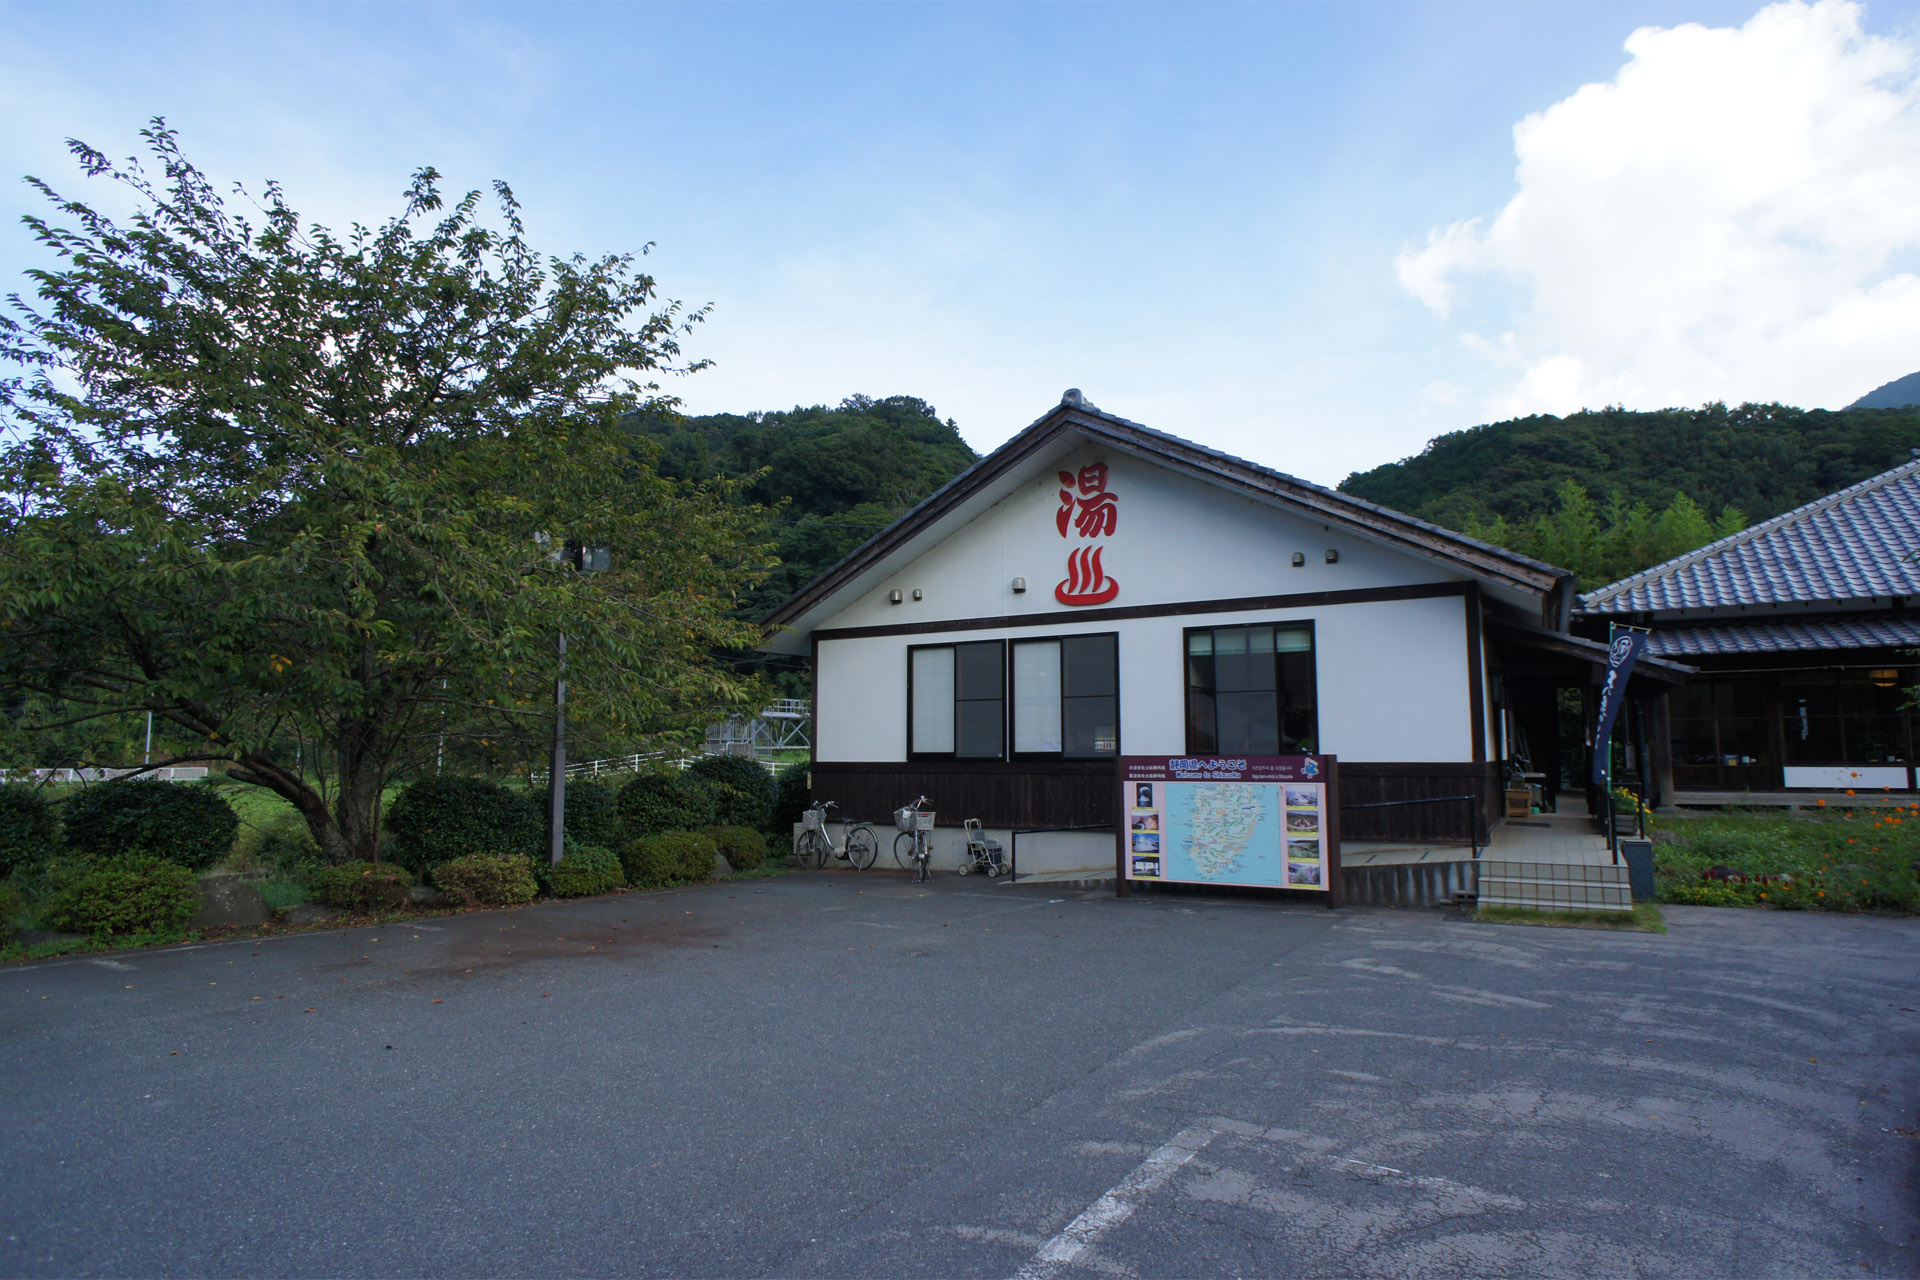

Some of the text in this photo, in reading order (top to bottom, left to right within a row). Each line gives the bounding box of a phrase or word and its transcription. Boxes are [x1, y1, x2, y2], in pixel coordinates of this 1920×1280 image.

[1056, 461, 1118, 538] 湯
[1169, 759, 1247, 770] 静岡県へようこそ
[1212, 771, 1241, 779] Shizuoka
